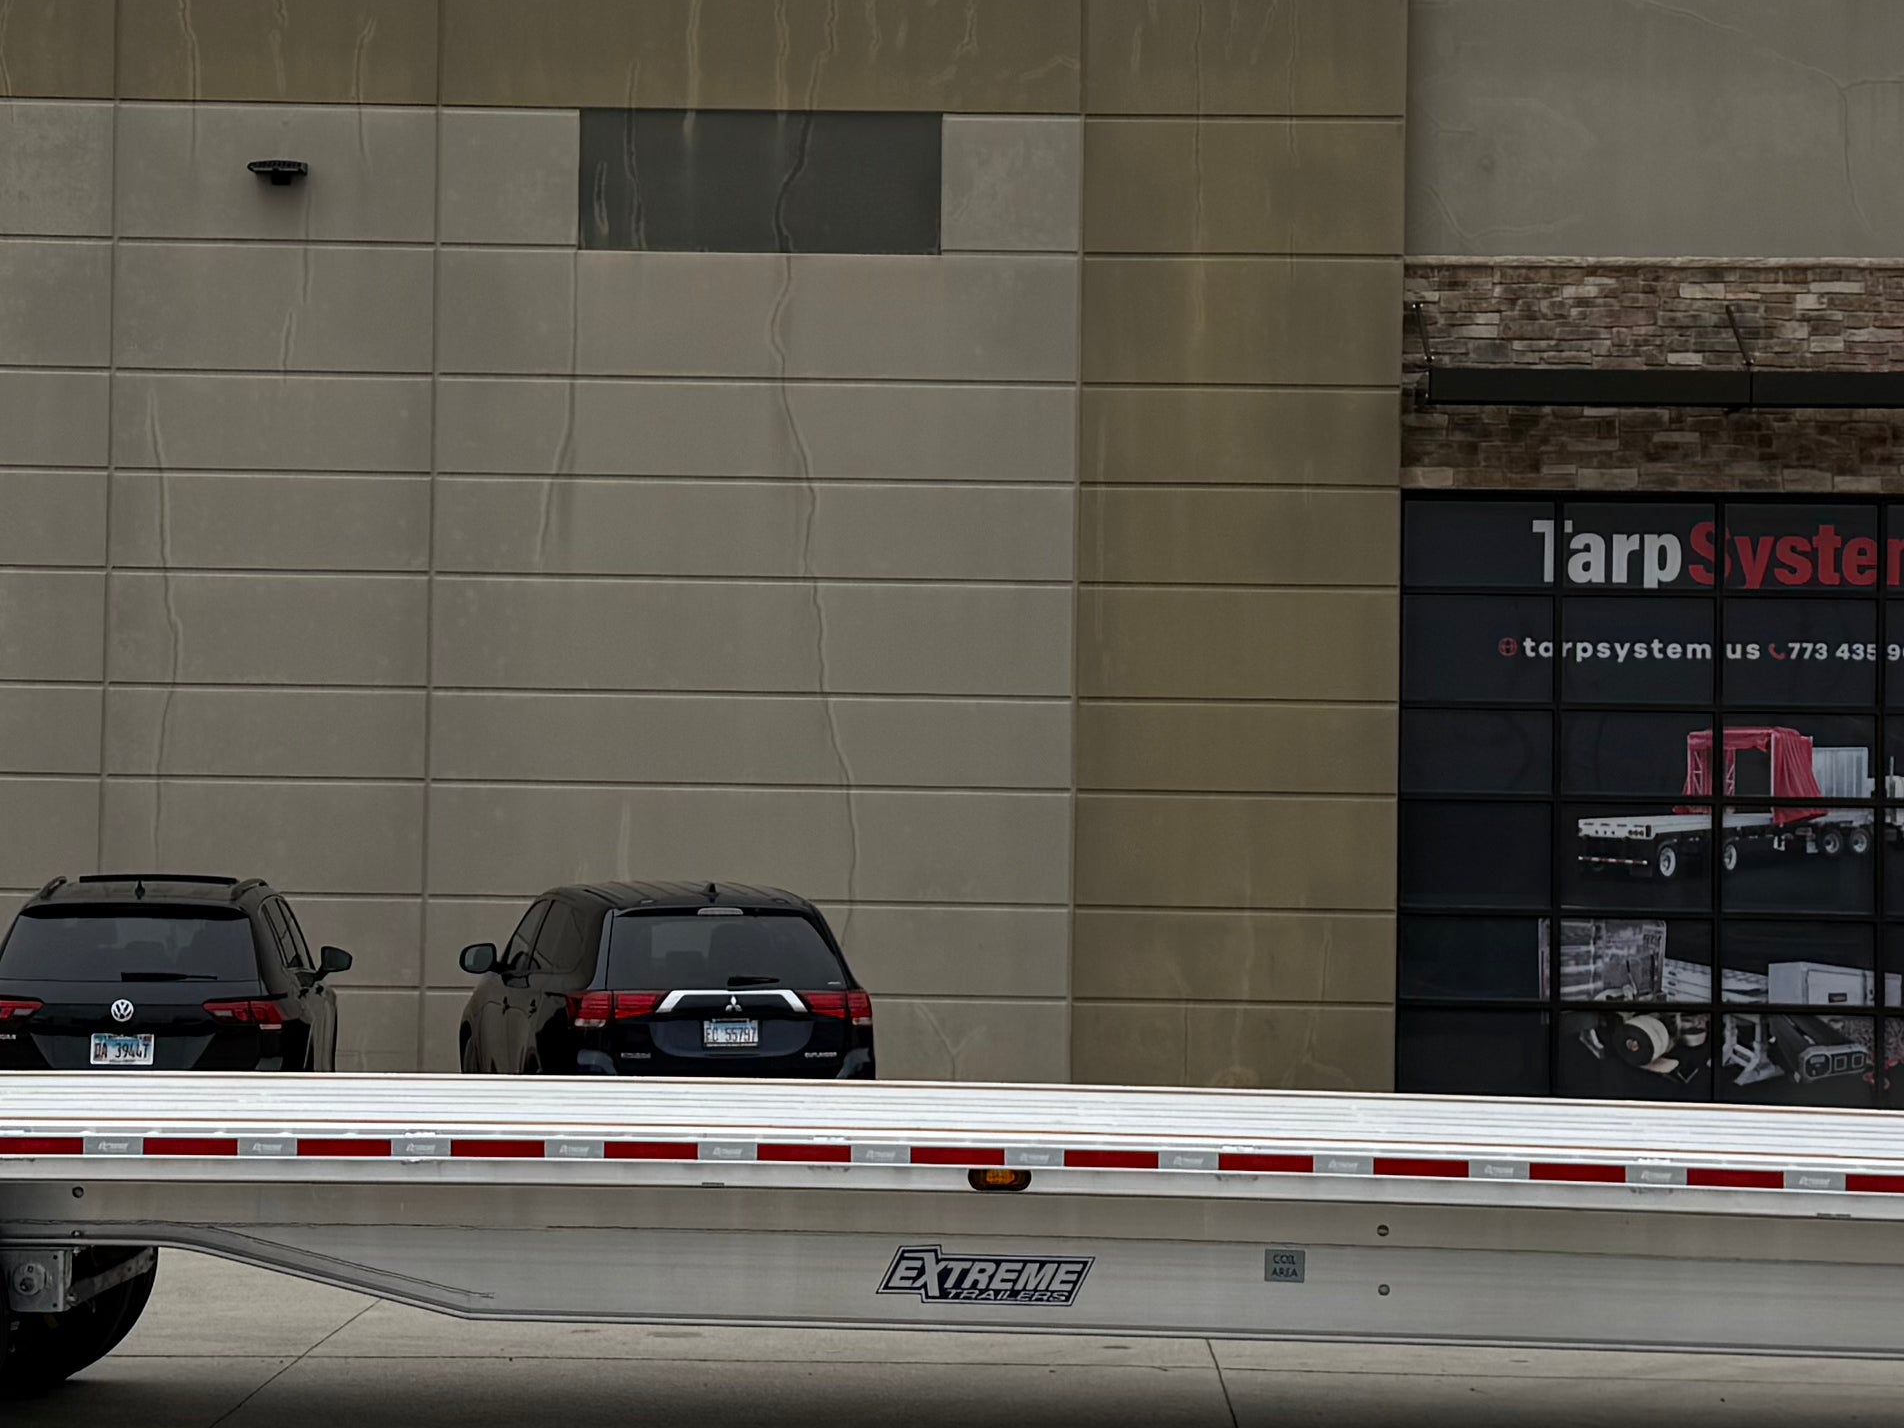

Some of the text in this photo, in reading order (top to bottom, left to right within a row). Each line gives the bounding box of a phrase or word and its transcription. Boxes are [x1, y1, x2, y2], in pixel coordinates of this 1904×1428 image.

[1522, 636, 1761, 662] tarpsystemus
[1788, 642, 1828, 661] 773
[1835, 642, 1878, 661] 435
[887, 1251, 1084, 1297] EXTREME
[946, 1289, 1069, 1302] TRAILERS
